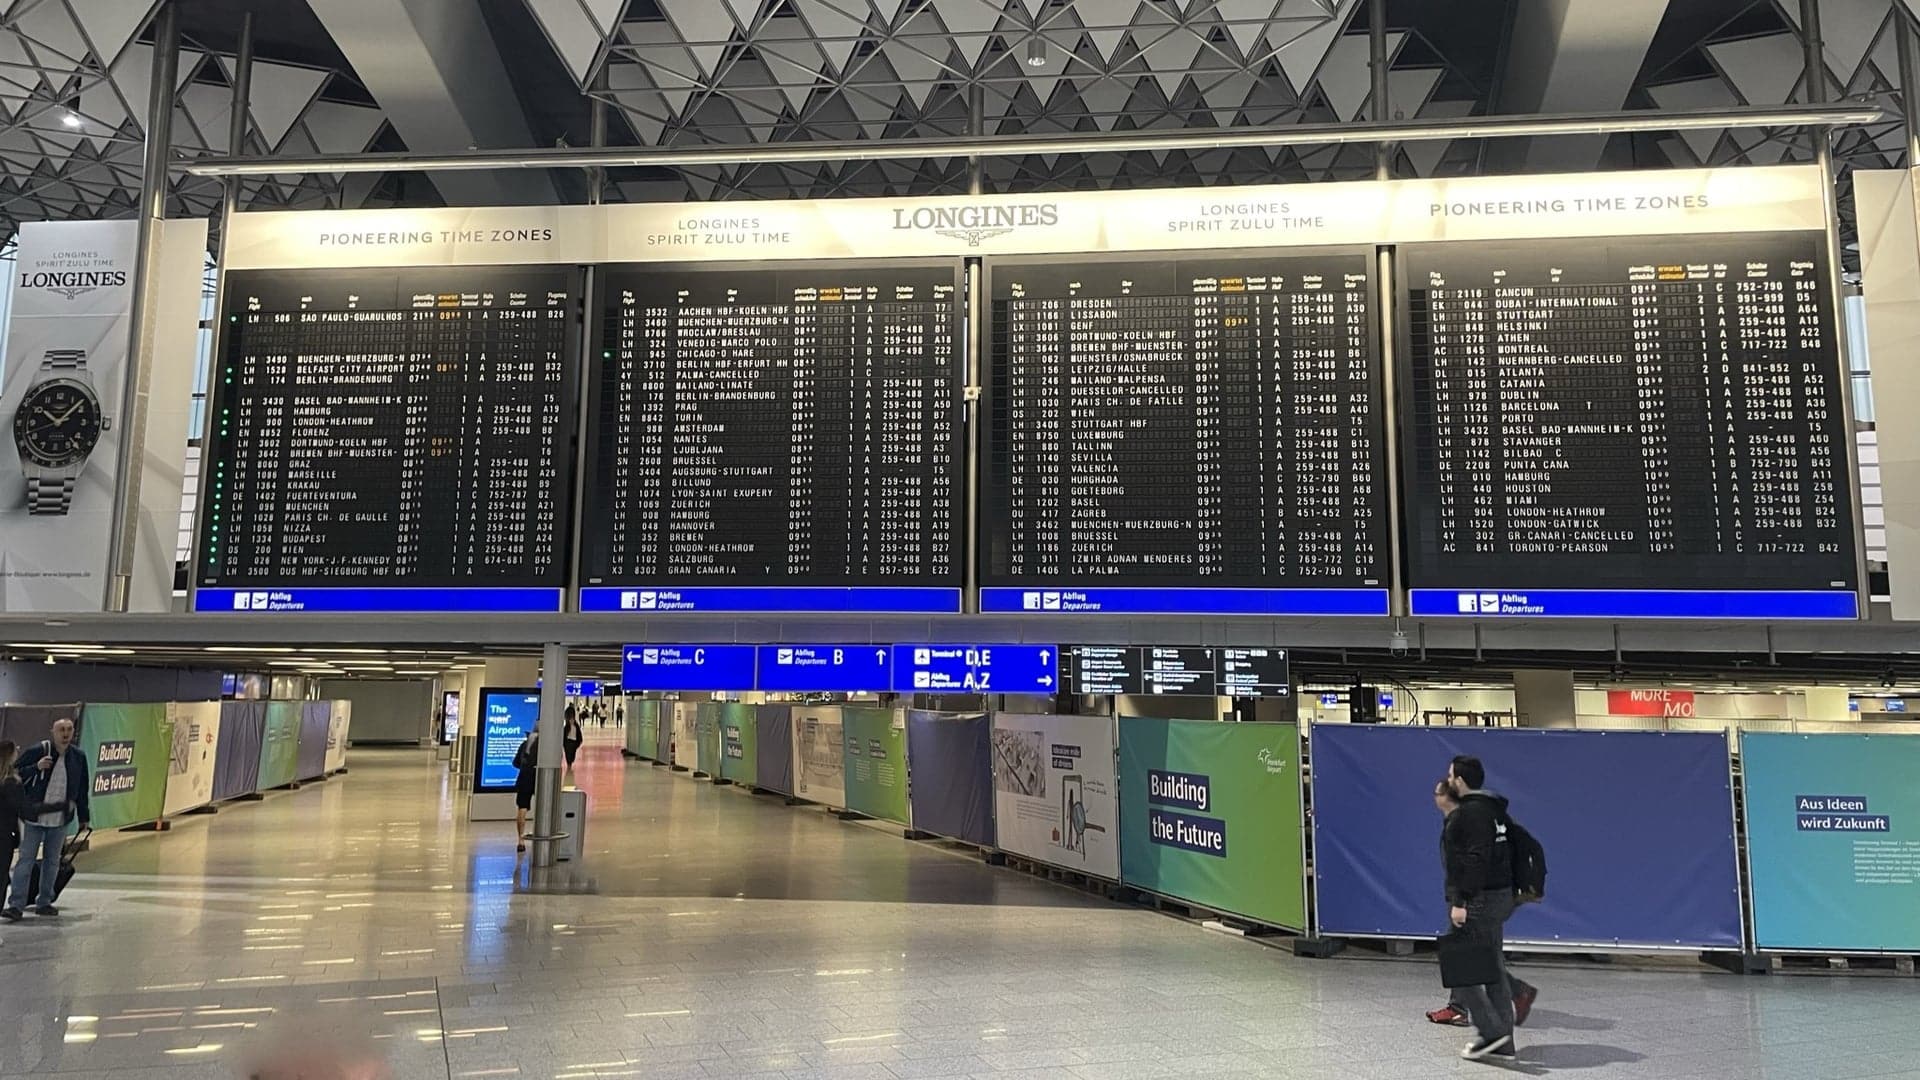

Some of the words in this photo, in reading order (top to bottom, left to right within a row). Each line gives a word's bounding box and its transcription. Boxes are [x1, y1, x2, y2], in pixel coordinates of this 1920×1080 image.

[1201, 202, 1290, 216] LONGINES
[1430, 200, 1564, 216] PIONEERING
[1574, 198, 1626, 212] TIME
[1635, 195, 1709, 210] ZONES
[893, 204, 1058, 229] LONGINES
[678, 218, 760, 230] LONGINES
[1168, 220, 1222, 232] SPIRIT
[1230, 218, 1274, 231] ZULU
[1282, 216, 1324, 229] TIME
[320, 231, 433, 245] PIONEERING
[440, 230, 483, 242] TIME
[491, 229, 552, 242] ZONES
[647, 234, 698, 245] SPIRIT
[704, 233, 745, 244] ZULU
[752, 232, 790, 243] TIME
[36, 260, 63, 268] SPIRIT
[21, 271, 126, 288] LONGINES
[1495, 288, 1534, 296] CANCUN
[1070, 300, 1112, 308] DRESDEN
[1070, 311, 1118, 319] LISSABON
[1496, 310, 1554, 319] STUTTGART
[1070, 322, 1094, 330] GENF
[1496, 322, 1547, 330] HELSINKI
[754, 338, 777, 347] POLO
[1497, 334, 1530, 342] ATHEN
[732, 349, 754, 357] HARE
[1071, 365, 1147, 373] LEIPZIG/HALLE
[1499, 368, 1545, 376] ATLANTA
[1499, 379, 1545, 388] CATANIA
[1500, 391, 1540, 400] DUBLIN
[1071, 398, 1101, 406] PARIS
[1106, 397, 1123, 406] CH.
[1129, 397, 1141, 406] DE
[675, 402, 698, 411] PRAG
[1501, 402, 1560, 411] BARCELONA
[675, 413, 703, 422] TURIN
[1501, 414, 1534, 422] PORTO
[673, 435, 707, 443] NANTES
[1503, 437, 1561, 446] STAVANGER
[673, 445, 724, 454] LJUBLJANA
[1072, 442, 1113, 451] TALLINN
[1071, 453, 1113, 462] SEVILLA
[1503, 449, 1543, 457] BILBAO
[672, 456, 716, 465] BRUESSEL
[1503, 460, 1537, 469] PUNTA
[1543, 460, 1570, 469] CANA
[1071, 464, 1119, 473] VALENCIA
[671, 478, 711, 487] BILLUND
[1071, 475, 1119, 484] HURGHADA
[671, 489, 727, 498] LYON-SAINT
[733, 488, 773, 497] EXUPERY
[1070, 487, 1125, 495] GOETEBORG
[1505, 484, 1551, 493] HOUSTON
[671, 500, 711, 509] ZUERICH
[1071, 498, 1099, 506] BASEL
[1071, 509, 1107, 518] ZAGREB
[670, 521, 715, 530] HANNOVER
[1071, 532, 1118, 540] BRUESSEL
[1071, 543, 1113, 552] ZUERICH
[668, 555, 714, 563] SALZBURG
[1107, 554, 1138, 563] ADNAN
[667, 566, 691, 574] GRAN
[696, 565, 737, 574] CANARIA
[1071, 566, 1083, 575] LA
[270, 592, 292, 601] Abflug
[659, 591, 681, 601] Abflug
[1062, 592, 1086, 601] Abflug
[1501, 594, 1527, 604] Abflug
[269, 601, 305, 610] Departures
[658, 601, 695, 610] Departures
[1062, 602, 1101, 611] Departures
[1502, 604, 1544, 614] Departures
[660, 649, 680, 657] Abflug
[695, 648, 705, 665] C
[795, 649, 815, 657] Abflug
[833, 648, 844, 665] B
[660, 657, 692, 666] Departures
[795, 658, 827, 666] Departures
[1631, 690, 1671, 702] MORE
[490, 704, 508, 714] The
[1663, 702, 1695, 717] MO
[488, 726, 521, 736] Airport
[99, 744, 133, 764] Building
[94, 774, 110, 792] the
[110, 774, 135, 790] Future
[1151, 774, 1207, 810] Building
[1800, 799, 1824, 810] Aus
[1827, 799, 1864, 810] Ideen
[1801, 817, 1831, 829] wird
[1834, 817, 1886, 830] Zukunft
[1152, 815, 1174, 840] the
[1177, 820, 1222, 850] Future
